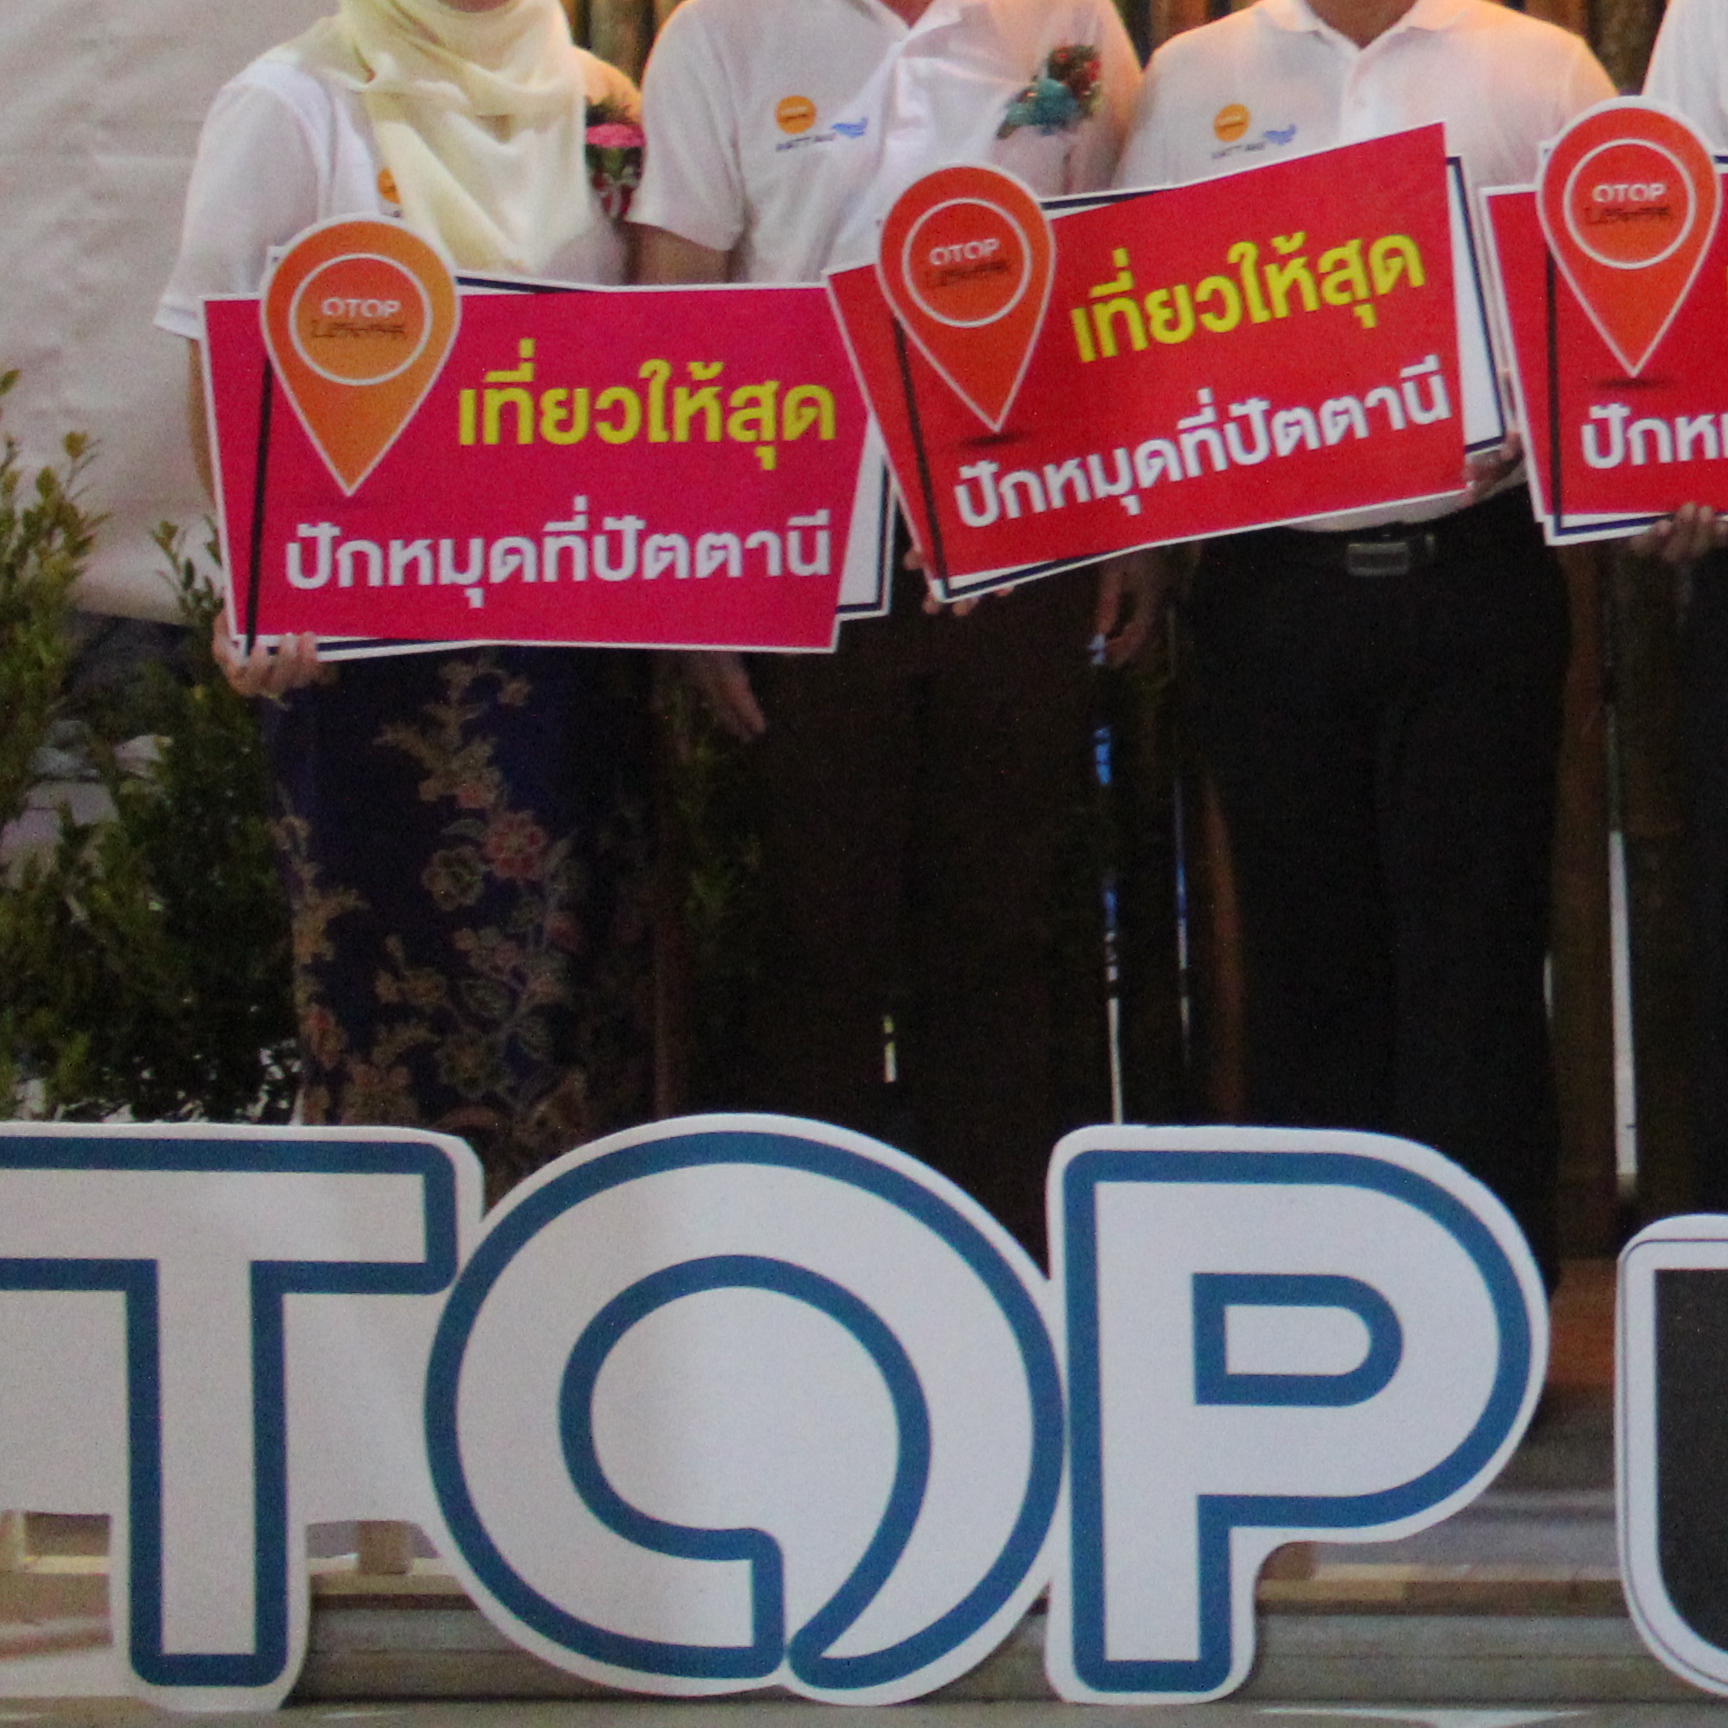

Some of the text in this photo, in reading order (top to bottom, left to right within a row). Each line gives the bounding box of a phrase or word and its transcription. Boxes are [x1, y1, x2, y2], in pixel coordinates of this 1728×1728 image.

[1591, 181, 1668, 204] OTOP
[321, 296, 402, 319] OTOP
[928, 237, 1002, 267] OTOP
[1070, 231, 1426, 363] เที่ยวให้สุด
[458, 338, 836, 471] เที่ยวให้สุด
[954, 353, 1451, 528] ปักหมุดที่ปัตตานี
[285, 494, 832, 609] ปักหมุดที่ปัตตานี
